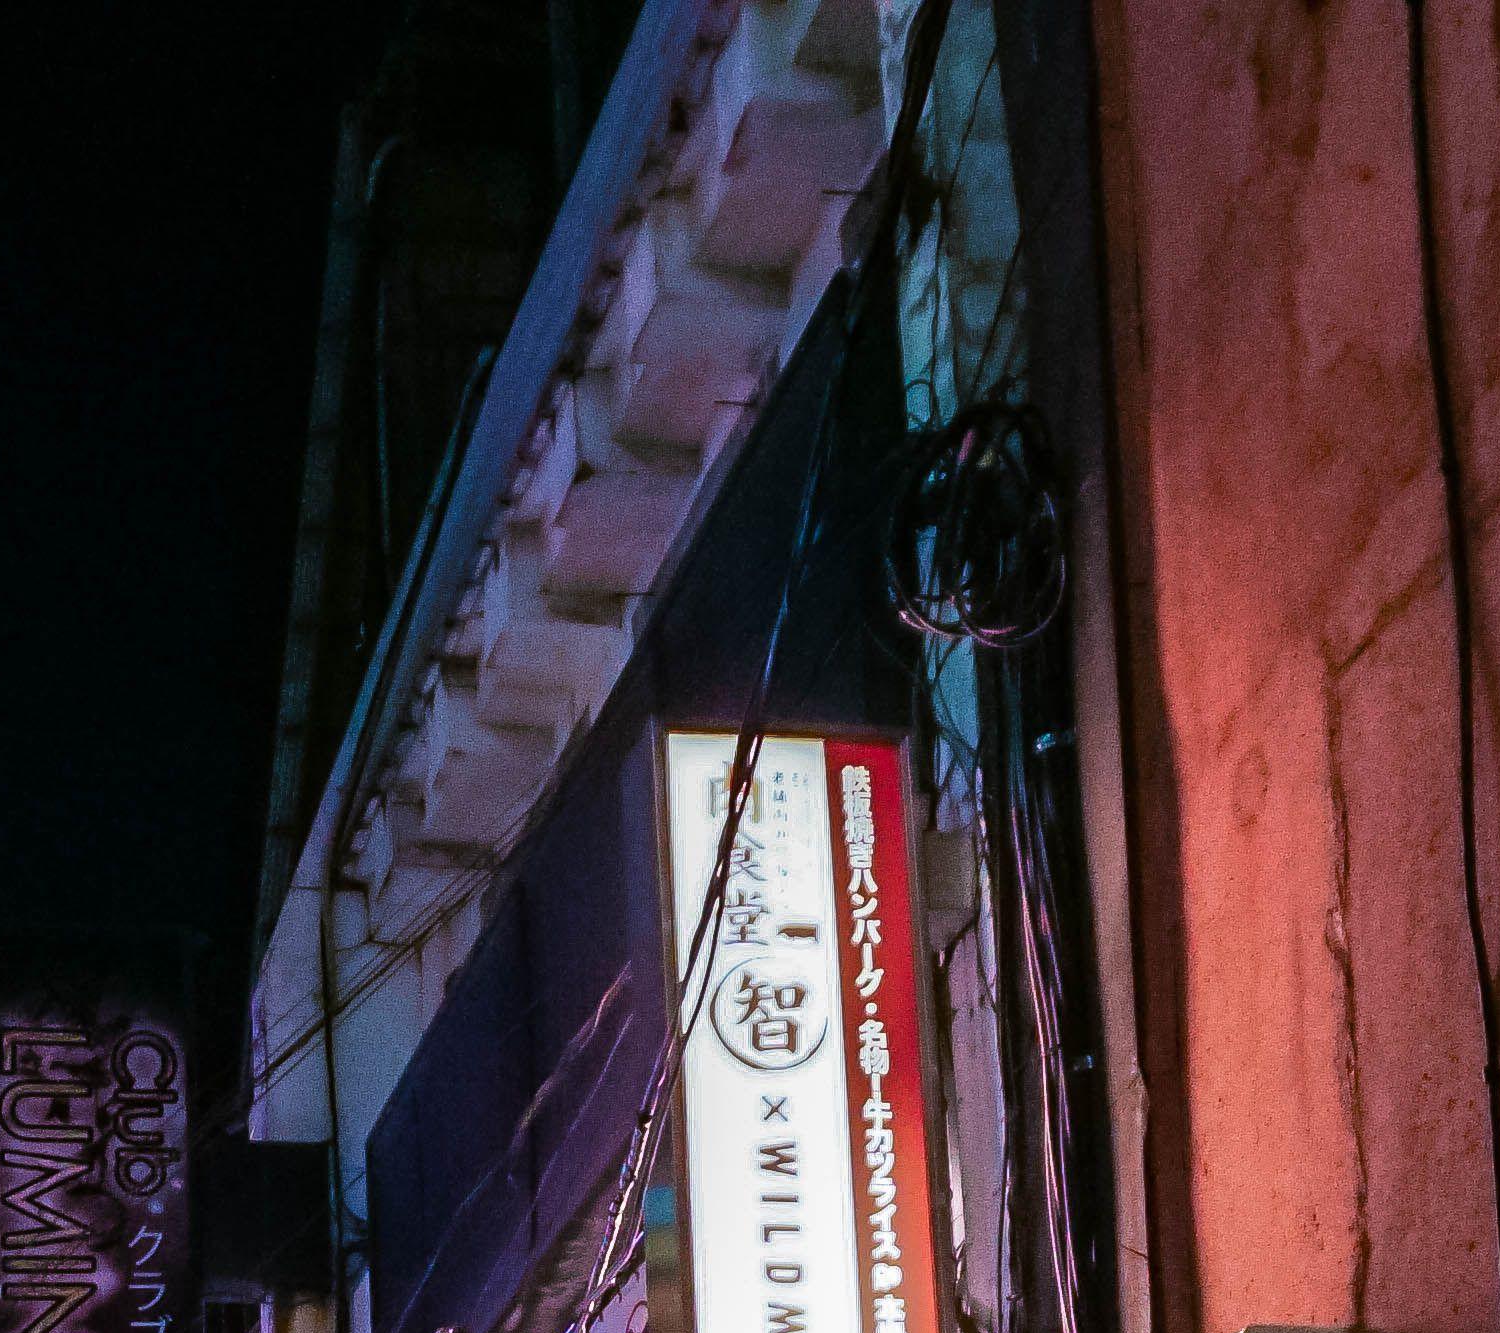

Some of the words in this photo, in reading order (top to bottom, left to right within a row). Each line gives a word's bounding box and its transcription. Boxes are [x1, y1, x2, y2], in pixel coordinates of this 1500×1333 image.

[708, 760, 769, 946] 肉食堂
[734, 972, 807, 1055] 智
[110, 1029, 180, 1196] Club
